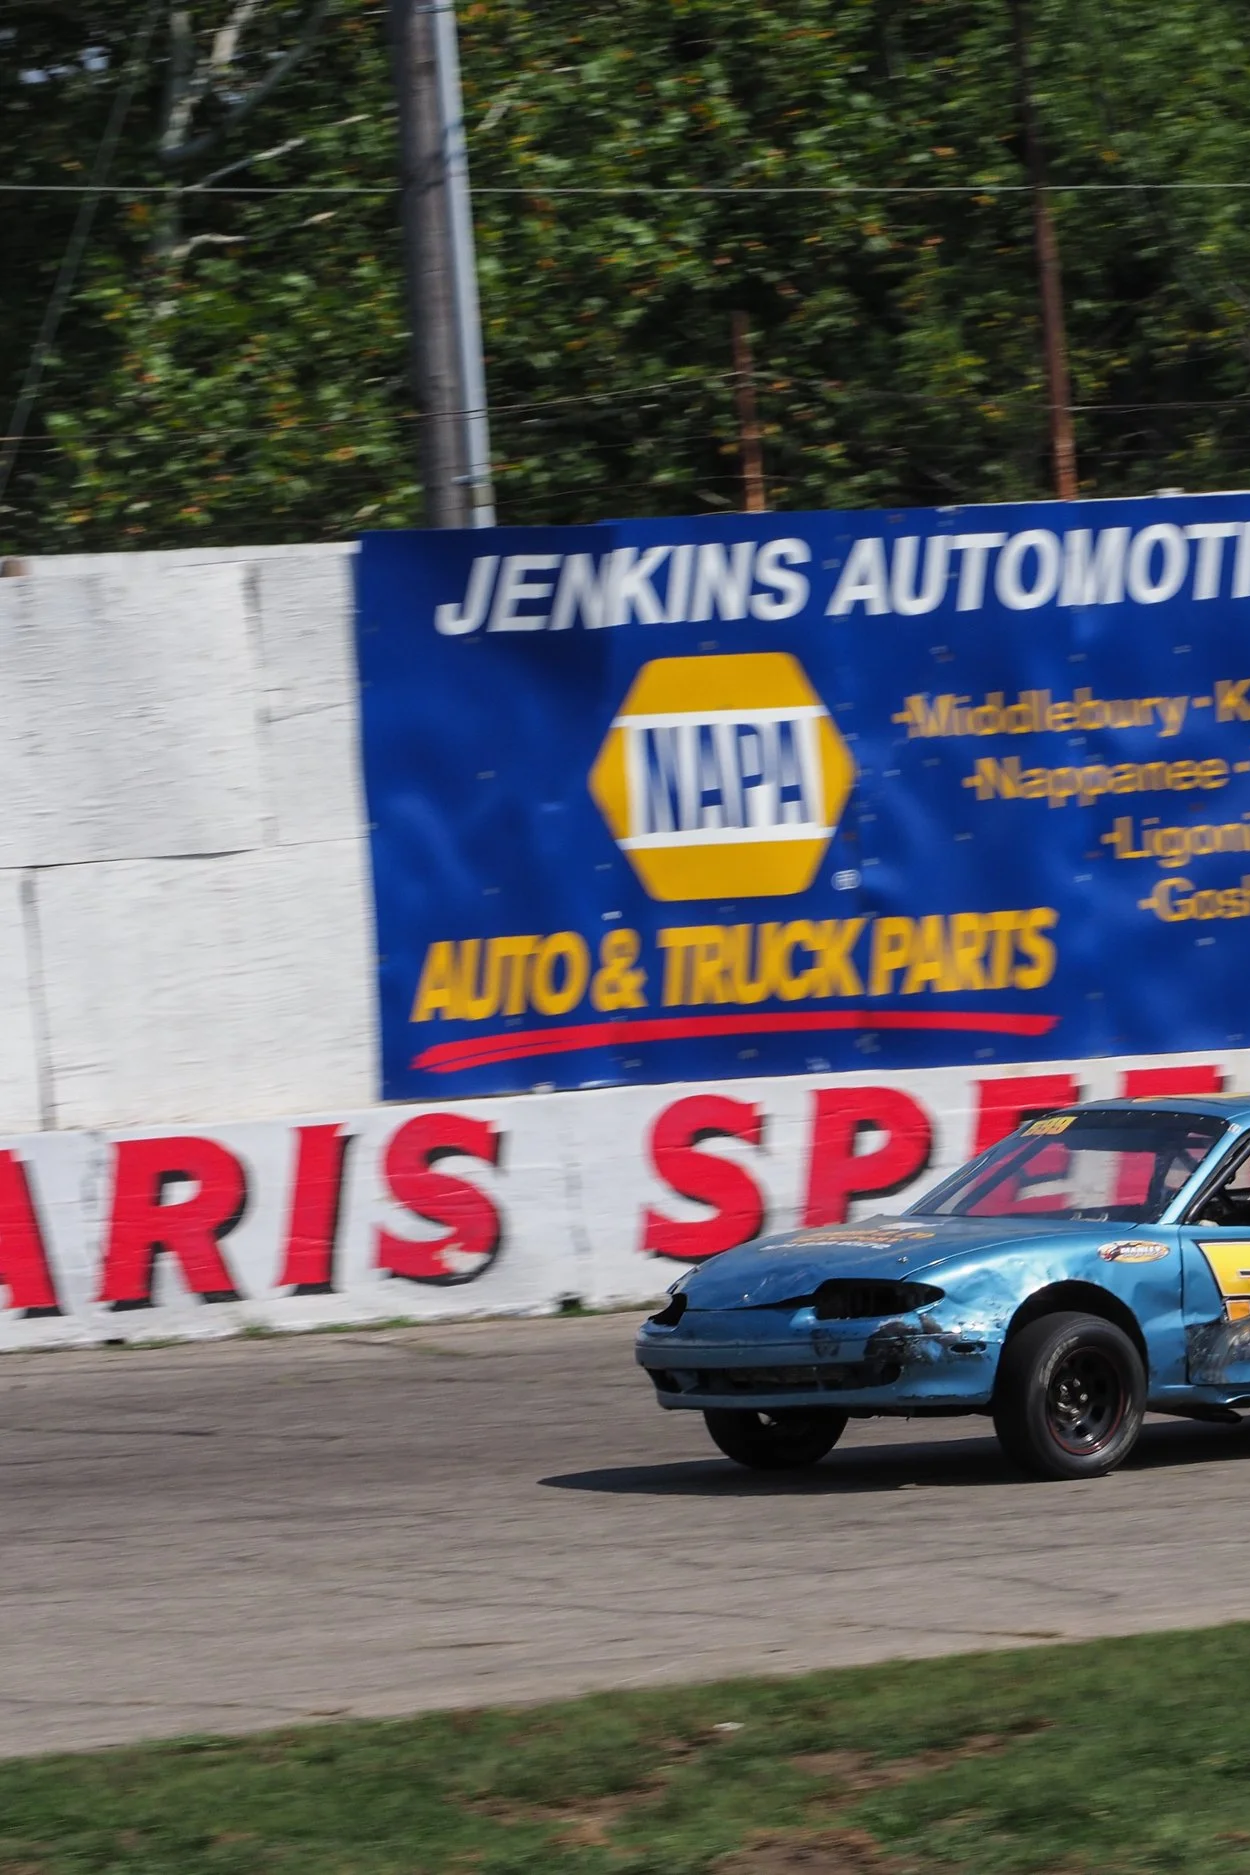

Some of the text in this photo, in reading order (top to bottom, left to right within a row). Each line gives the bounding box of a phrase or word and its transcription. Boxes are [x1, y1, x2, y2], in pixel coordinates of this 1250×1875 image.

[436, 537, 811, 635] JENKINS
[645, 719, 818, 835] NAPA
[410, 907, 1058, 1022] AUTO & TRUCK PARTS
